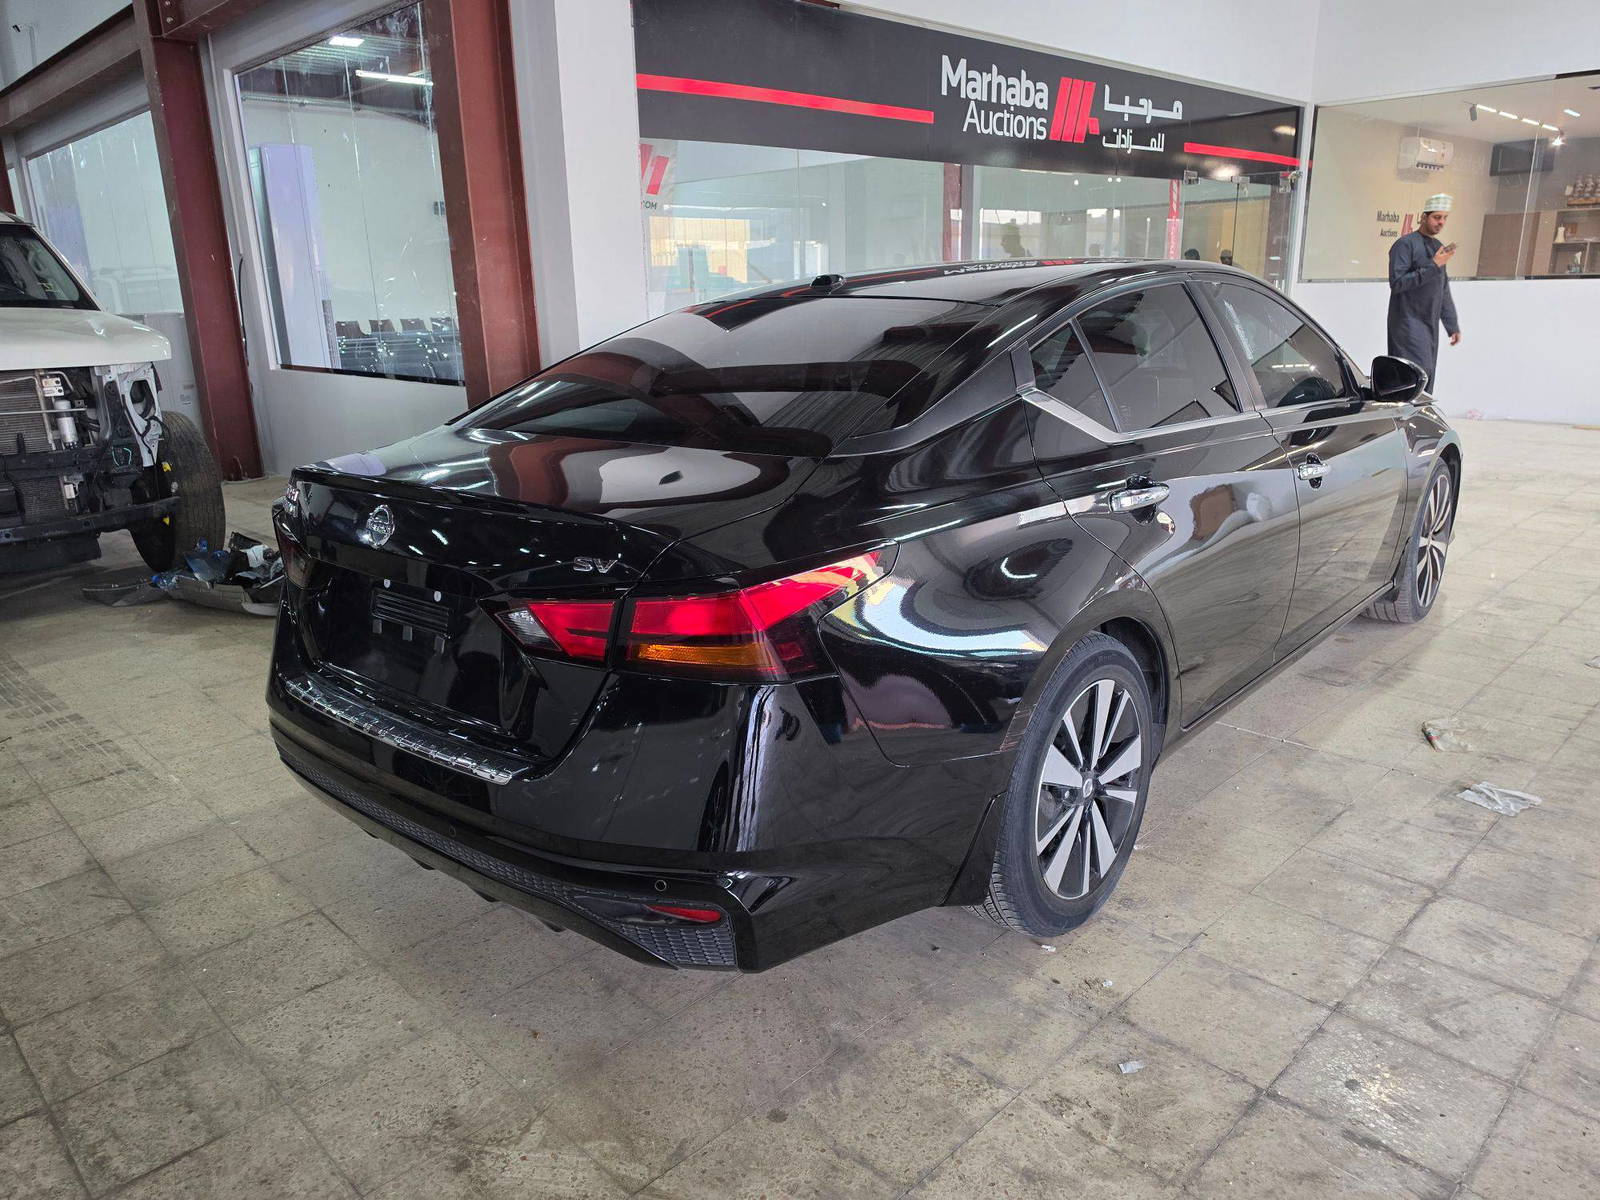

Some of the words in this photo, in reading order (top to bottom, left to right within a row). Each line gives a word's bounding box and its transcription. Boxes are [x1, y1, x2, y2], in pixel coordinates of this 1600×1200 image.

[941, 54, 1049, 111] Marhaba
[962, 100, 1048, 141] Auctions
[1104, 84, 1183, 124] مرحبا
[1102, 128, 1165, 154] للمزادات
[573, 556, 618, 574] SV
